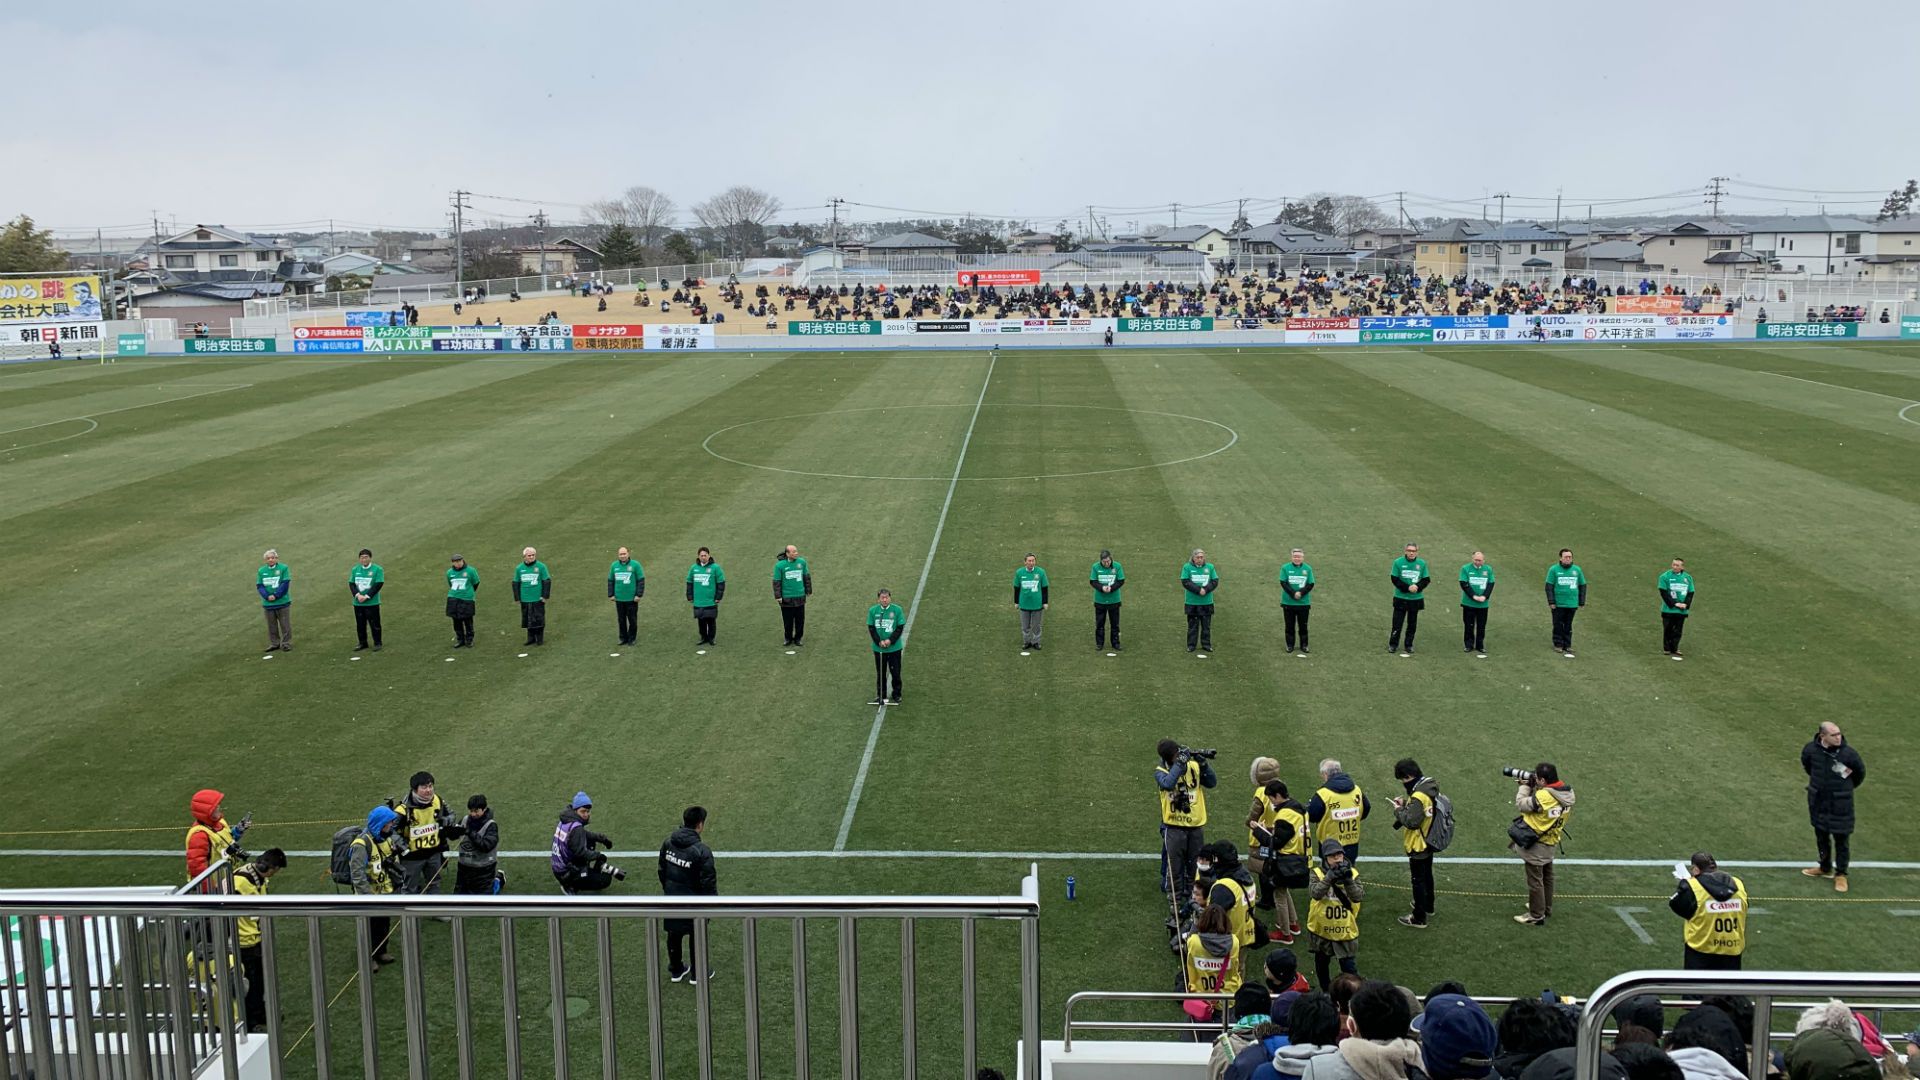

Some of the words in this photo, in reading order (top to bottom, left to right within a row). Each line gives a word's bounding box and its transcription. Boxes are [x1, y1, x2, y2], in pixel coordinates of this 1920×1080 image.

[0, 303, 70, 319] 会社大興
[1128, 318, 1202, 331] 明治安田生命
[1301, 320, 1350, 328] ミストソリューション
[1363, 318, 1432, 328] デーリー東北
[1525, 316, 1566, 325] HKUTO
[1681, 317, 1714, 325] 青森銀行
[310, 328, 362, 337] 八戸酒造株式会社
[377, 327, 430, 337] みちのく銀行
[598, 327, 628, 335] ナナヨウ
[799, 322, 871, 334] 明治安田生命
[1599, 328, 1657, 339] 大平洋金属
[1768, 324, 1847, 337] 明治安田生命
[20, 326, 98, 342] 朝日新聞
[1448, 329, 1506, 340] 八戸製錬
[195, 340, 265, 351] 明治安田生命
[450, 339, 495, 350] 功和産業
[585, 338, 631, 349] 環境技術
[1338, 819, 1358, 833] 012
[1710, 902, 1740, 911] Canon
[1326, 905, 1348, 920] 005
[1713, 939, 1738, 948] PHOT
[1198, 959, 1224, 970] Cano
